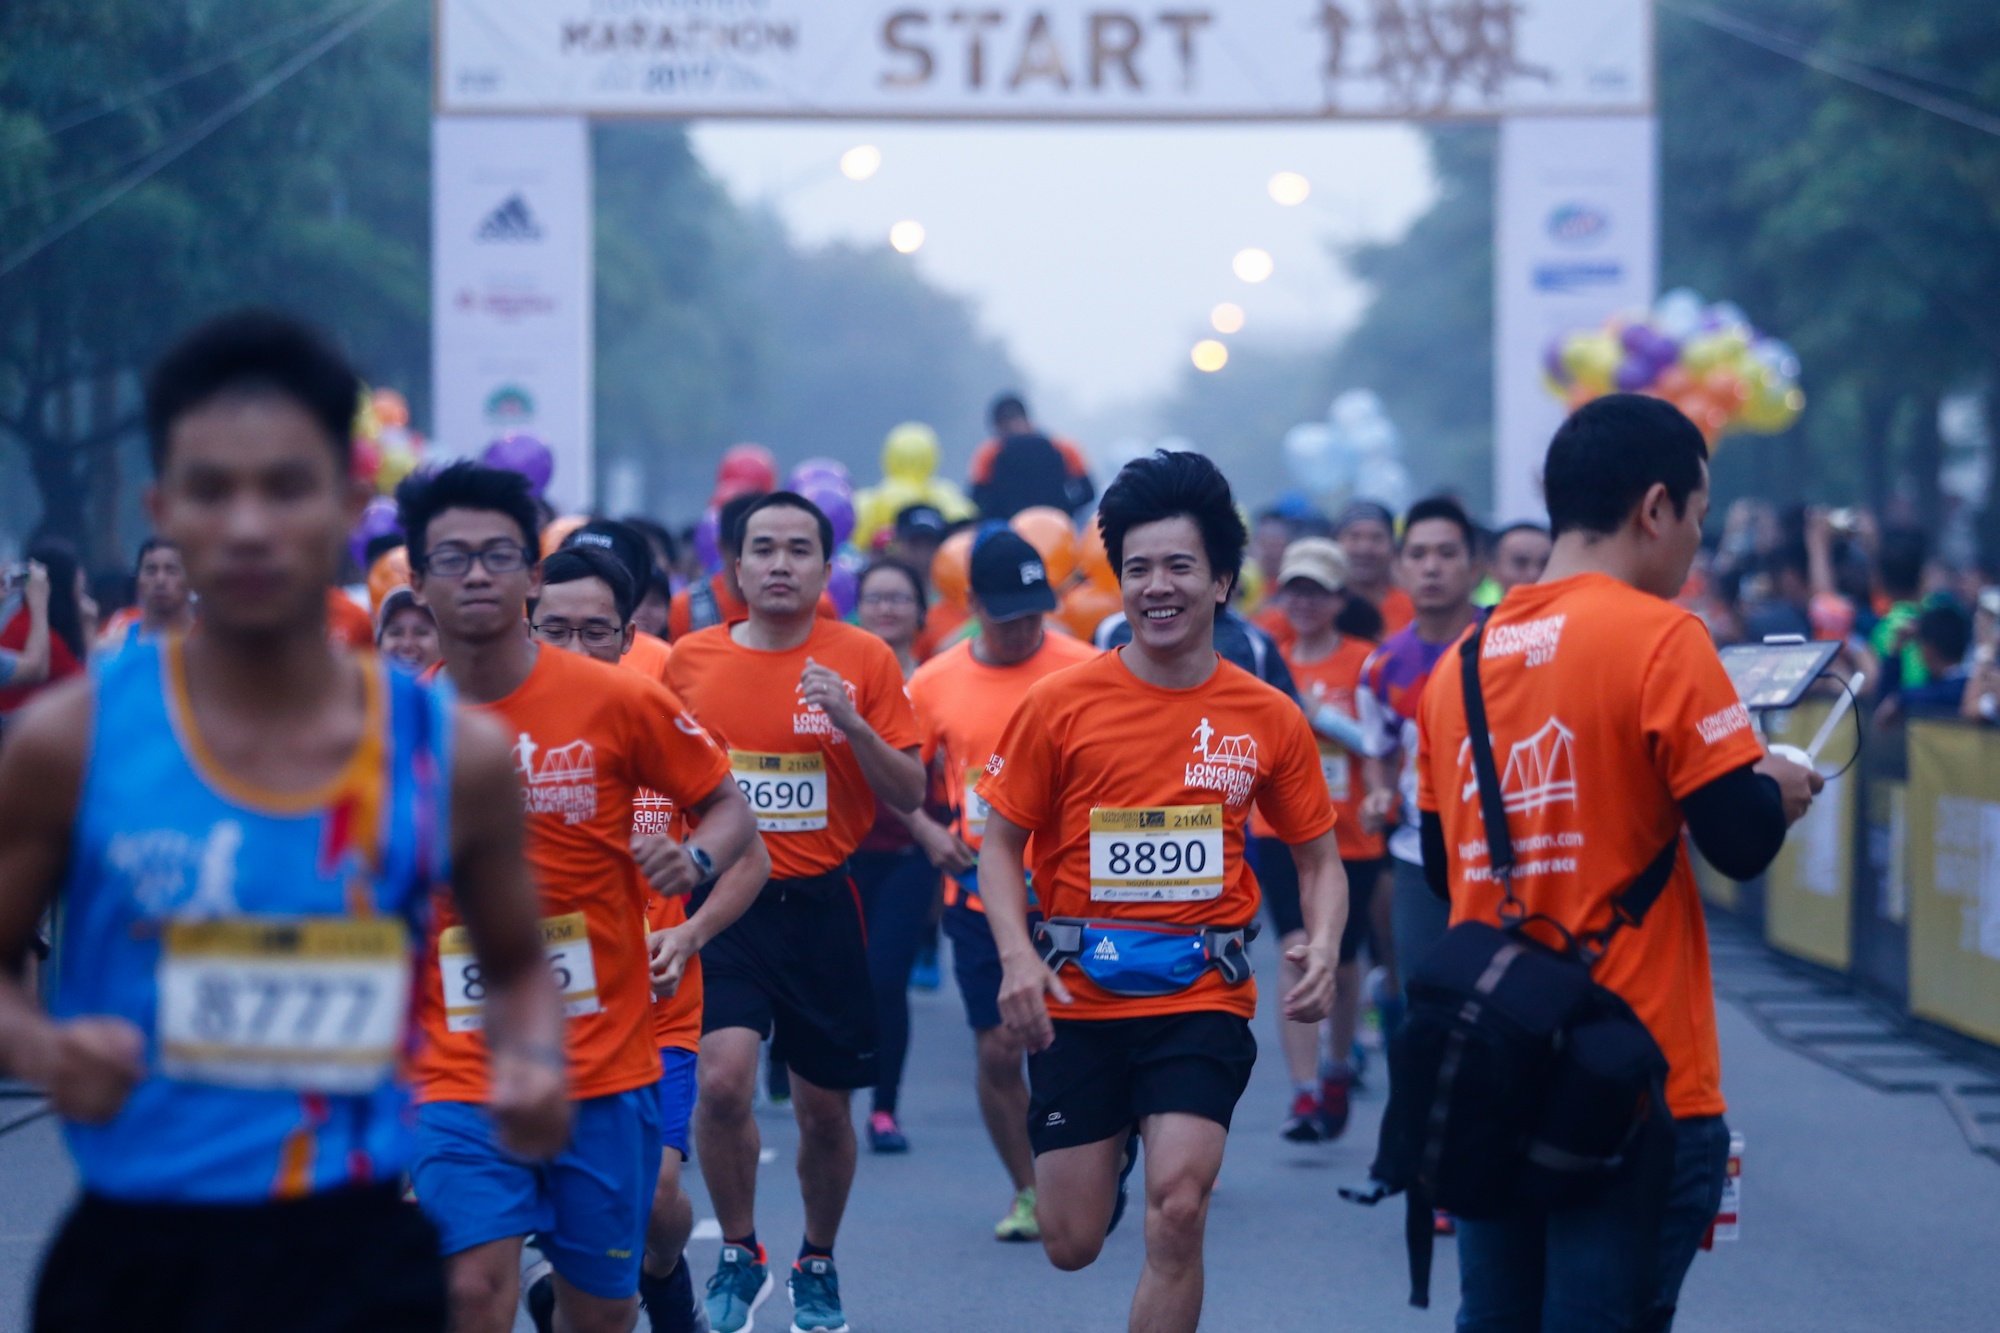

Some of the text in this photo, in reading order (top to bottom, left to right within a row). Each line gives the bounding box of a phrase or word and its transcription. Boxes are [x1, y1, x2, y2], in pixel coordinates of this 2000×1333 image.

[880, 10, 1214, 92] START
[793, 713, 831, 726] LONG
[1185, 763, 1256, 785] LONGBIEN
[1184, 775, 1251, 796] MARATHON
[524, 799, 596, 813] ARATHON
[1225, 793, 1247, 807] 2017
[1174, 814, 1212, 827] 21KM
[1109, 840, 1206, 875] 8890
